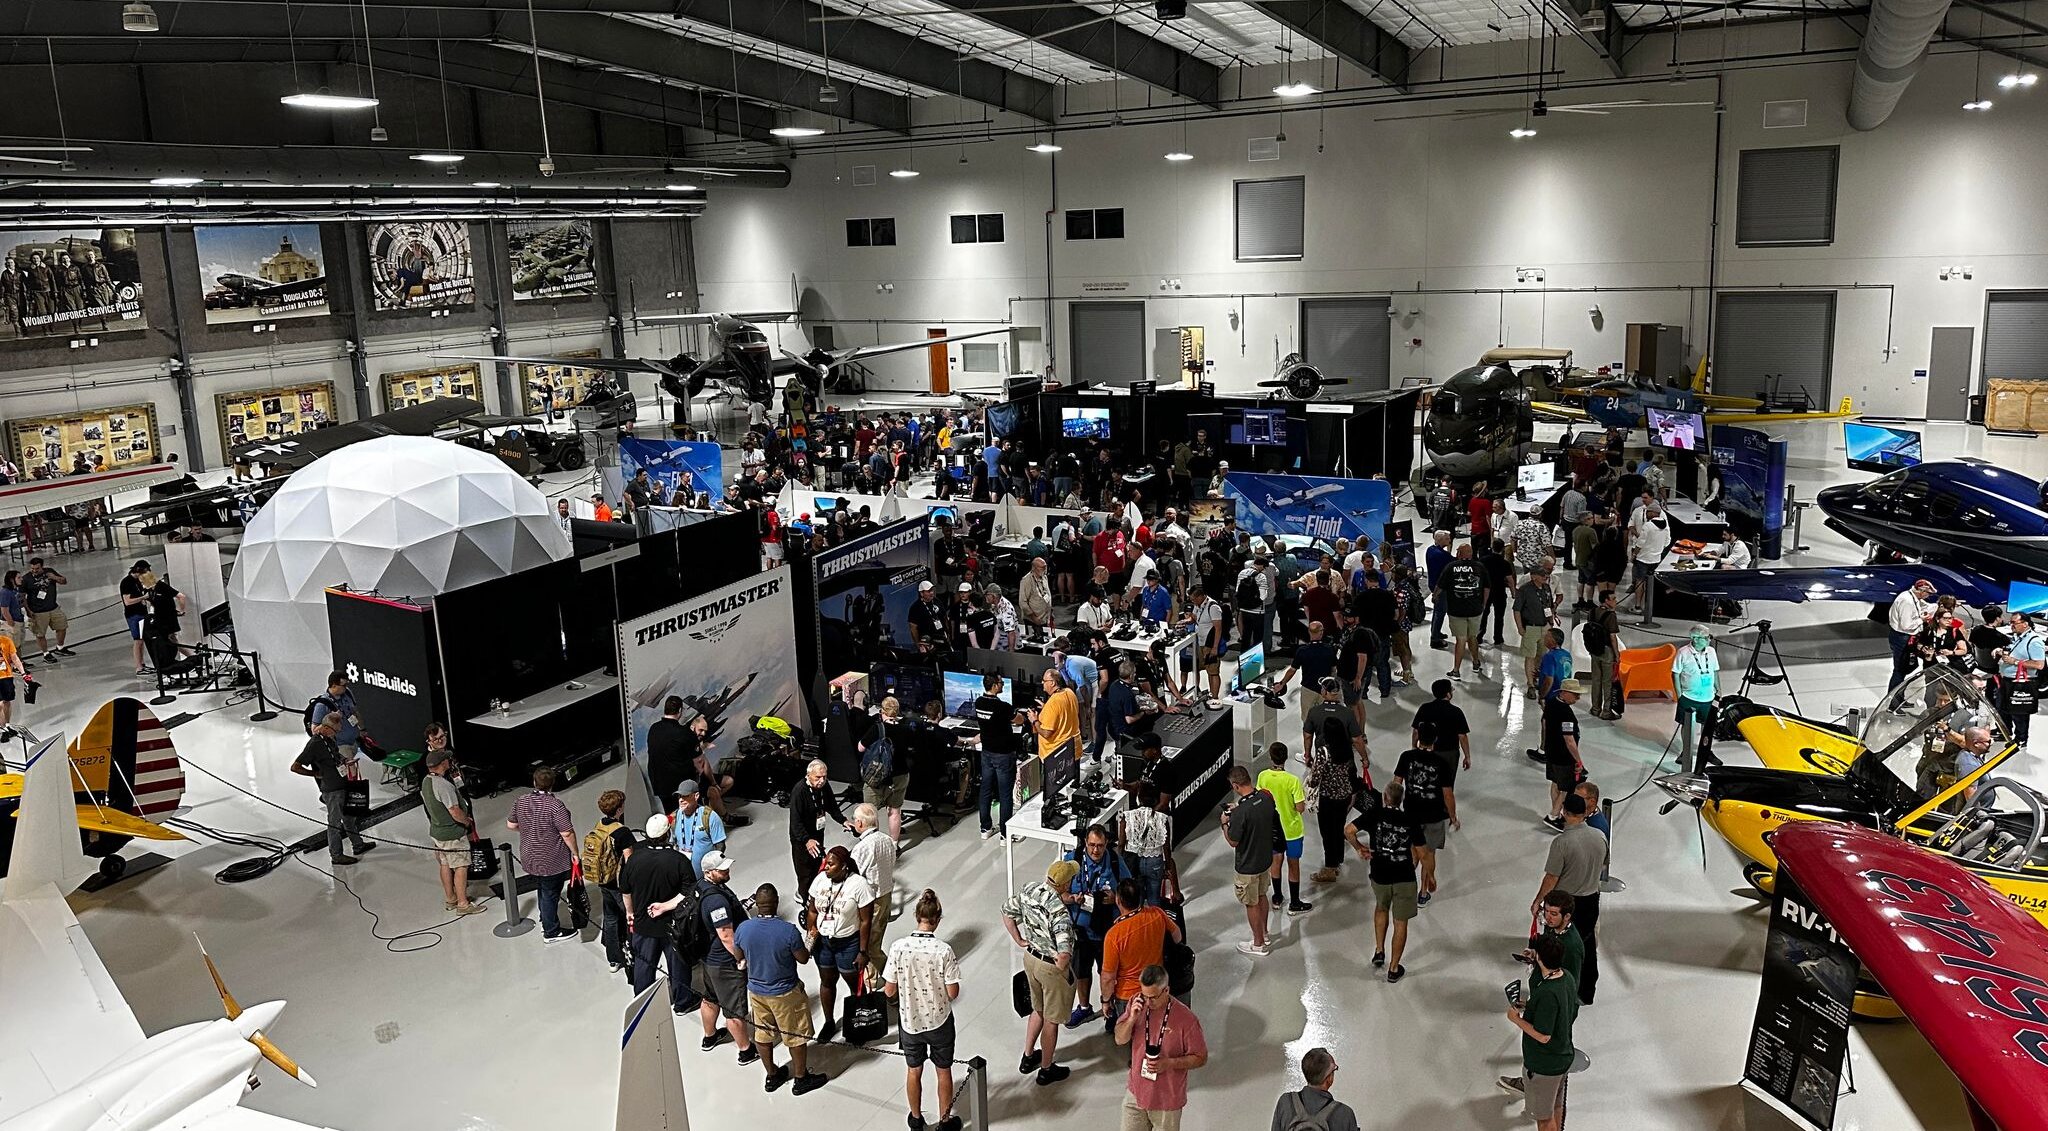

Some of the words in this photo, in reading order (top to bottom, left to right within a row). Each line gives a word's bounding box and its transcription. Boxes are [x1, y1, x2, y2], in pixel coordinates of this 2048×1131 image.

[283, 291, 308, 303] DOUGLAS
[308, 287, 323, 299] DC-3
[22, 314, 53, 327] WOMEN
[54, 309, 87, 323] AIRFORCE
[88, 304, 116, 317] SERVICE
[116, 300, 140, 313] PILOTS
[260, 303, 297, 315] Commercial
[297, 300, 306, 309] Air
[307, 298, 325, 308] Travel
[121, 310, 140, 321] WASP
[1606, 396, 1619, 411] 24
[1285, 514, 1306, 523] Microsoft
[1305, 514, 1343, 540] Flight
[822, 525, 922, 578] THRUSTMASTER
[889, 574, 903, 586] TCA
[902, 569, 915, 580] YOKE
[1453, 565, 1474, 573] NASA
[634, 579, 780, 647] THRUSTMASTER
[704, 625, 717, 635] SINCE
[363, 668, 417, 697] iniBuilds
[1174, 748, 1231, 809] THRUSTMASTER
[2008, 893, 2048, 909] RV-14
[1781, 896, 1854, 954] RV-1
